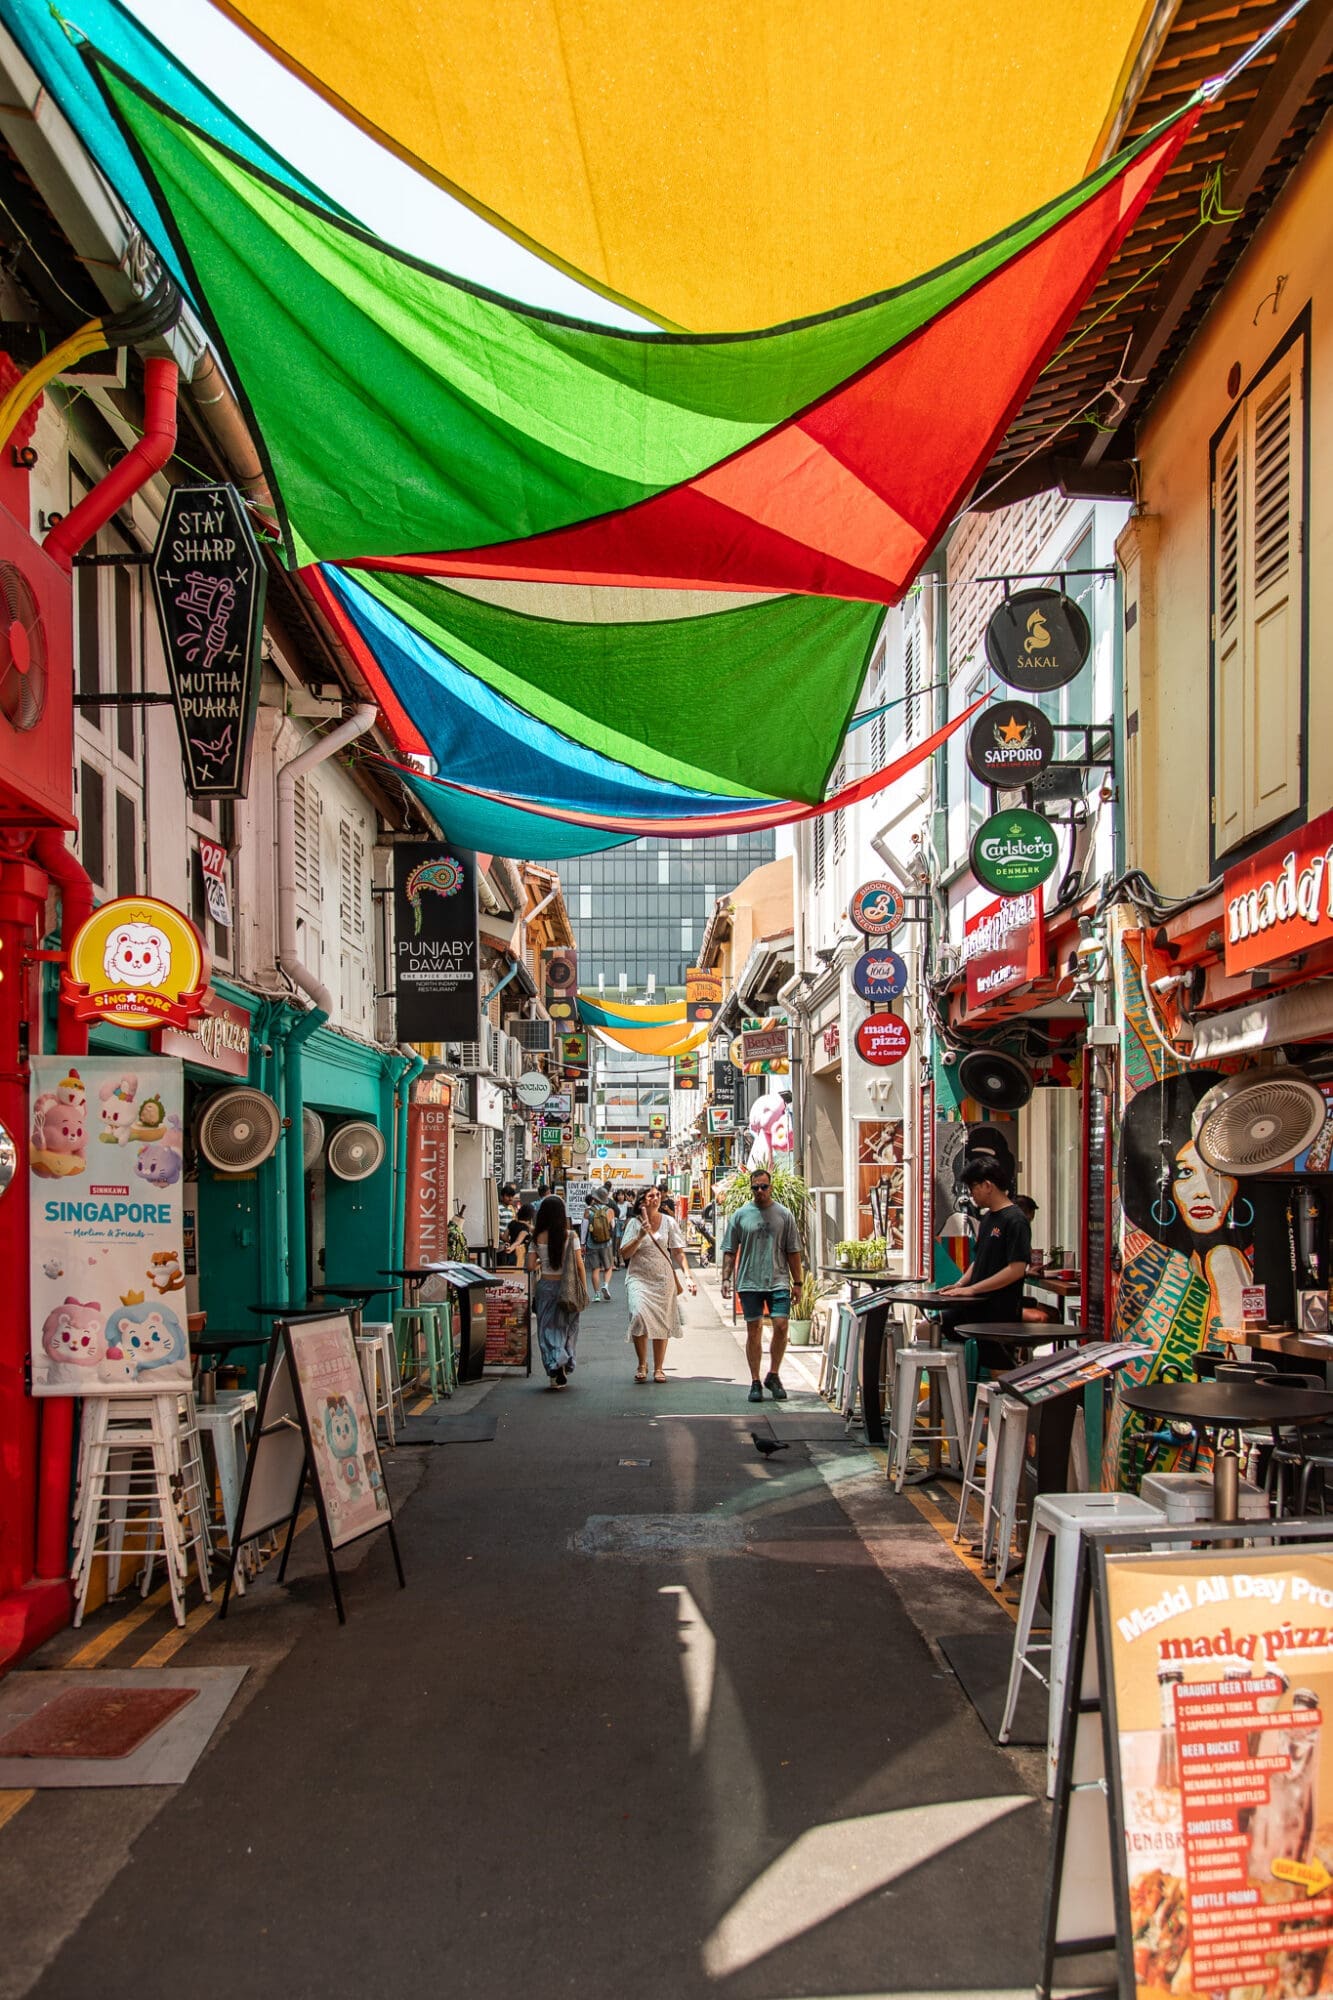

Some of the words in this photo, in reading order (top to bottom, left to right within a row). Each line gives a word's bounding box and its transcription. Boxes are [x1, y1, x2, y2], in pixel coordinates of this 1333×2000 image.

[179, 511, 225, 534] STAY
[173, 538, 236, 562] SHARP
[1017, 654, 1059, 671] ŠAKAL
[180, 672, 240, 694] MUTHA
[182, 697, 239, 718] PUAKA
[984, 748, 1042, 764] SAPPORO
[980, 838, 1053, 860] Carlsberg
[996, 866, 1040, 877] DENMARK
[860, 883, 900, 900] BROOKLYN
[1228, 851, 1325, 944] madd
[854, 909, 889, 933] DEFENDER
[399, 941, 473, 960] PUNJABY
[409, 959, 462, 972] DAWAT
[869, 965, 890, 977] 1664
[863, 986, 899, 996] BLANC
[115, 1003, 130, 1012] Gift
[131, 1004, 149, 1013] Gate
[863, 1024, 902, 1037] madd
[747, 1032, 785, 1049] Beryl's
[871, 1035, 907, 1050] pizza
[867, 1081, 893, 1101] 17
[422, 1112, 446, 1124] 16B
[543, 1130, 559, 1139] EXIT
[438, 1142, 447, 1205] RESORTWEAR
[419, 1134, 437, 1268] PINKSALT
[44, 1201, 172, 1224] SINGAPORE
[114, 1228, 146, 1238] Friends
[438, 1215, 446, 1262] WIMWEAR
[1122, 1243, 1172, 1298] SOUL
[1116, 1584, 1193, 1643] Madd
[1196, 1575, 1230, 1607] All
[1231, 1574, 1286, 1606] Day
[1159, 1627, 1259, 1662] madd
[1177, 1683, 1217, 1698] DRAUGHT
[1218, 1681, 1242, 1696] BEER
[1243, 1678, 1277, 1693] TOWERS
[1178, 1706, 1185, 1717] 2
[1185, 1702, 1225, 1716] CARLSBERG
[1225, 1700, 1253, 1713] TOWERS
[1179, 1721, 1186, 1732] 2
[1181, 1743, 1206, 1758] BEER
[1206, 1740, 1240, 1757] BUCKET
[1187, 1818, 1234, 1835] SHOOTERS
[1191, 1892, 1225, 1909] BOTTLE
[1226, 1889, 1258, 1906] PROMO
